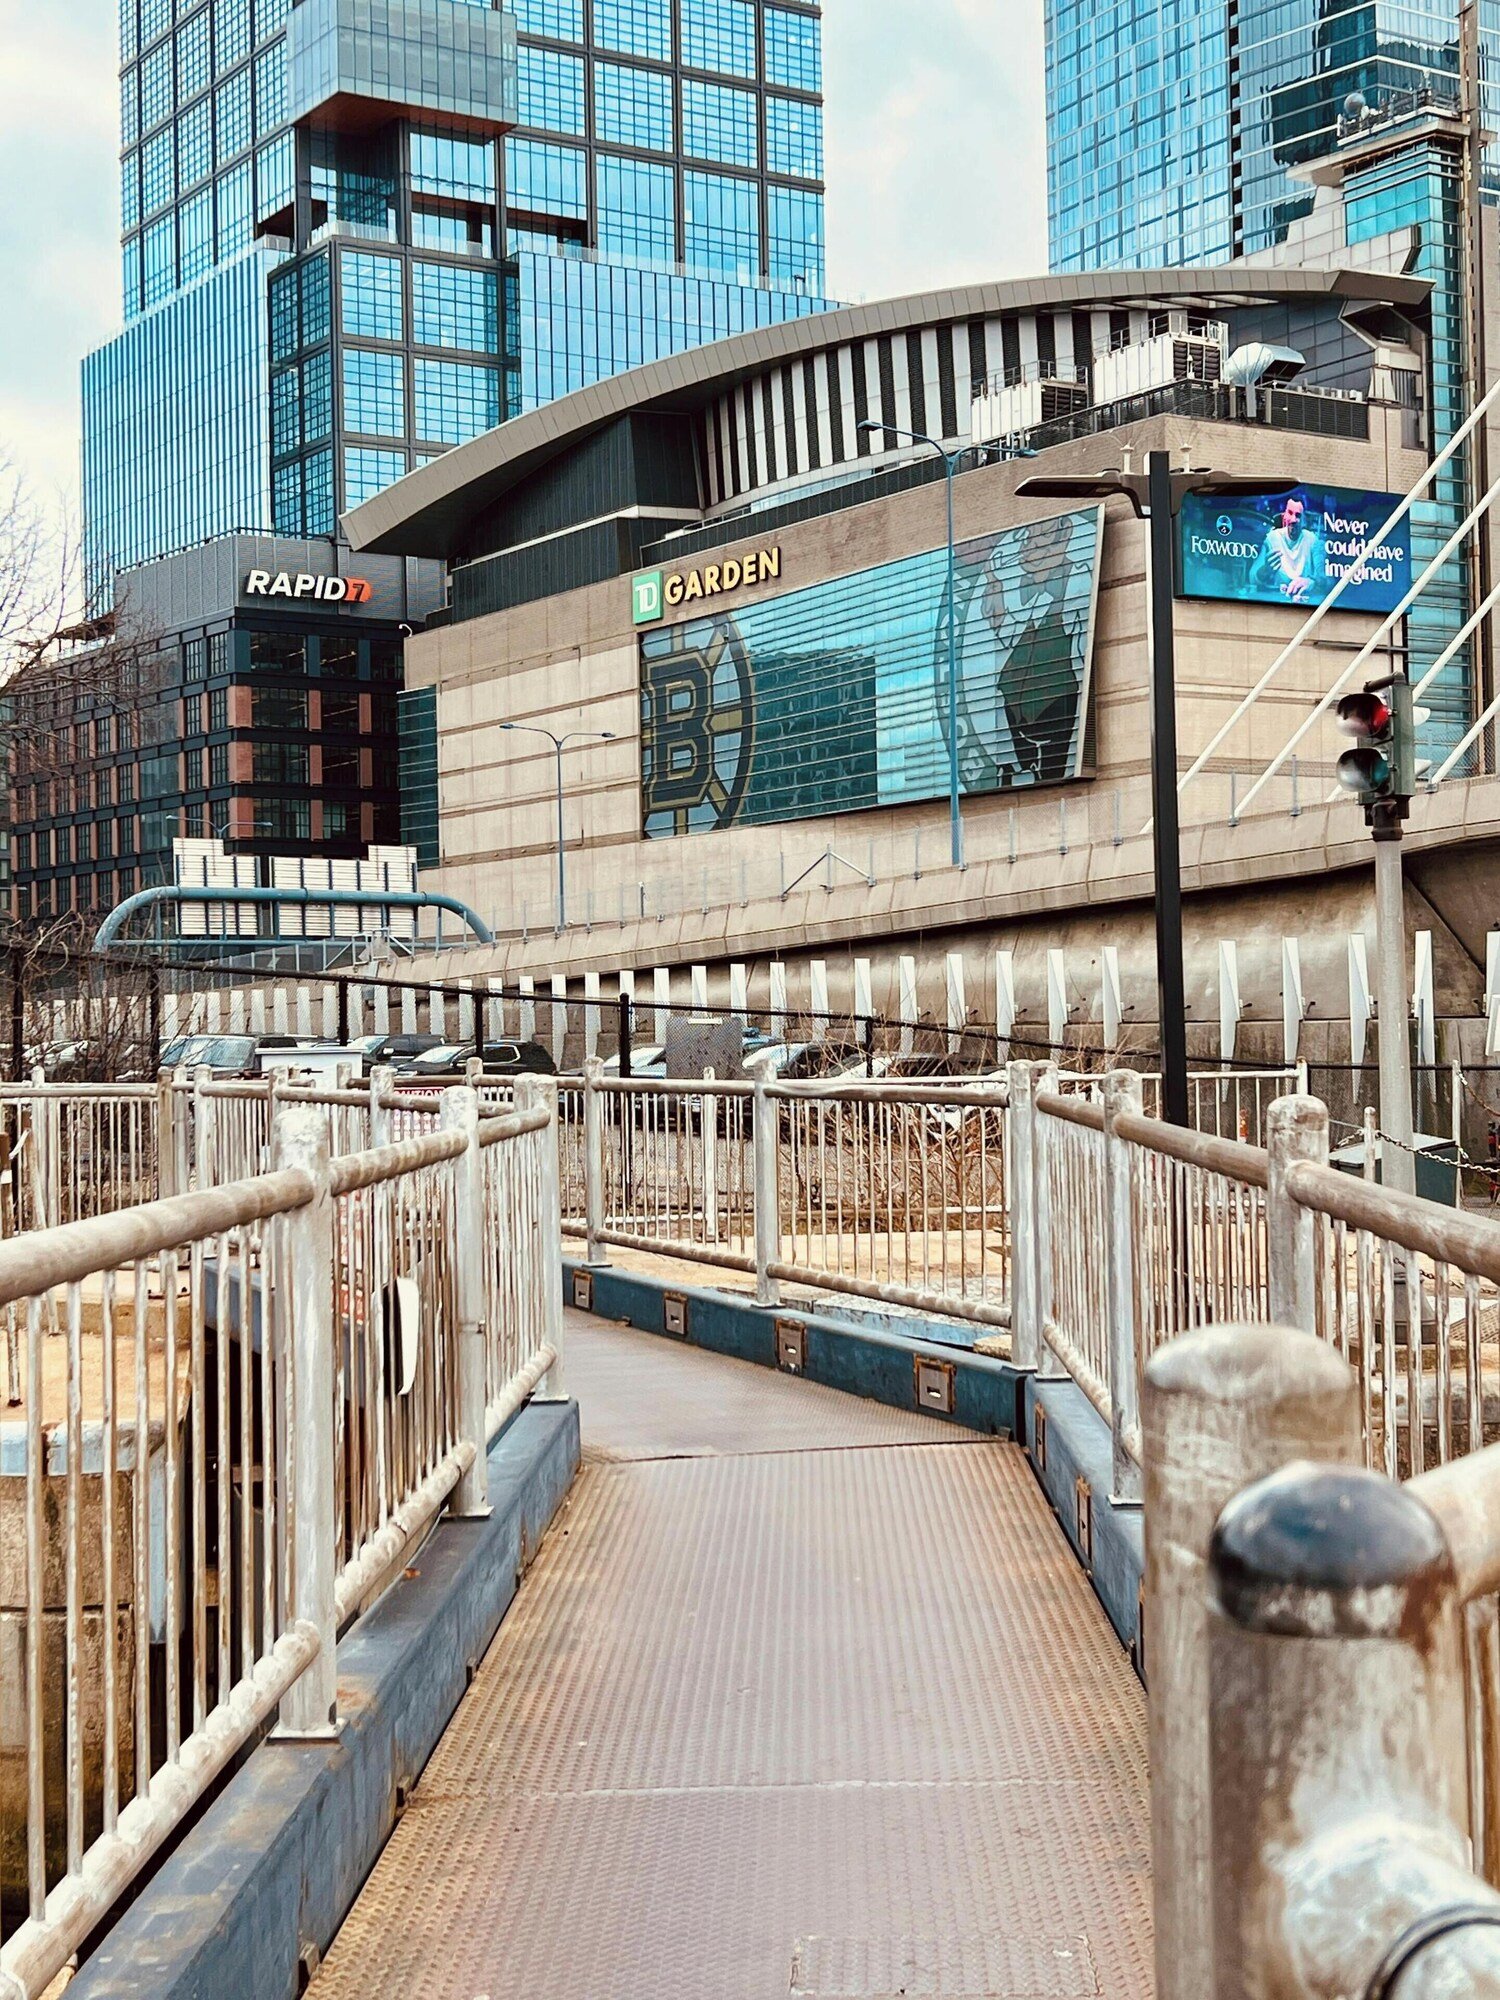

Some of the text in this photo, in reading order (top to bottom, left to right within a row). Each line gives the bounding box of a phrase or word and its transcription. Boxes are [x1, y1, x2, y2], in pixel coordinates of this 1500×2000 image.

[1323, 511, 1369, 535] Never
[1190, 535, 1259, 559] FOXWOODS
[1324, 537, 1366, 557] could
[246, 569, 373, 603] RAPID7
[634, 546, 781, 613] TD GARDEN
